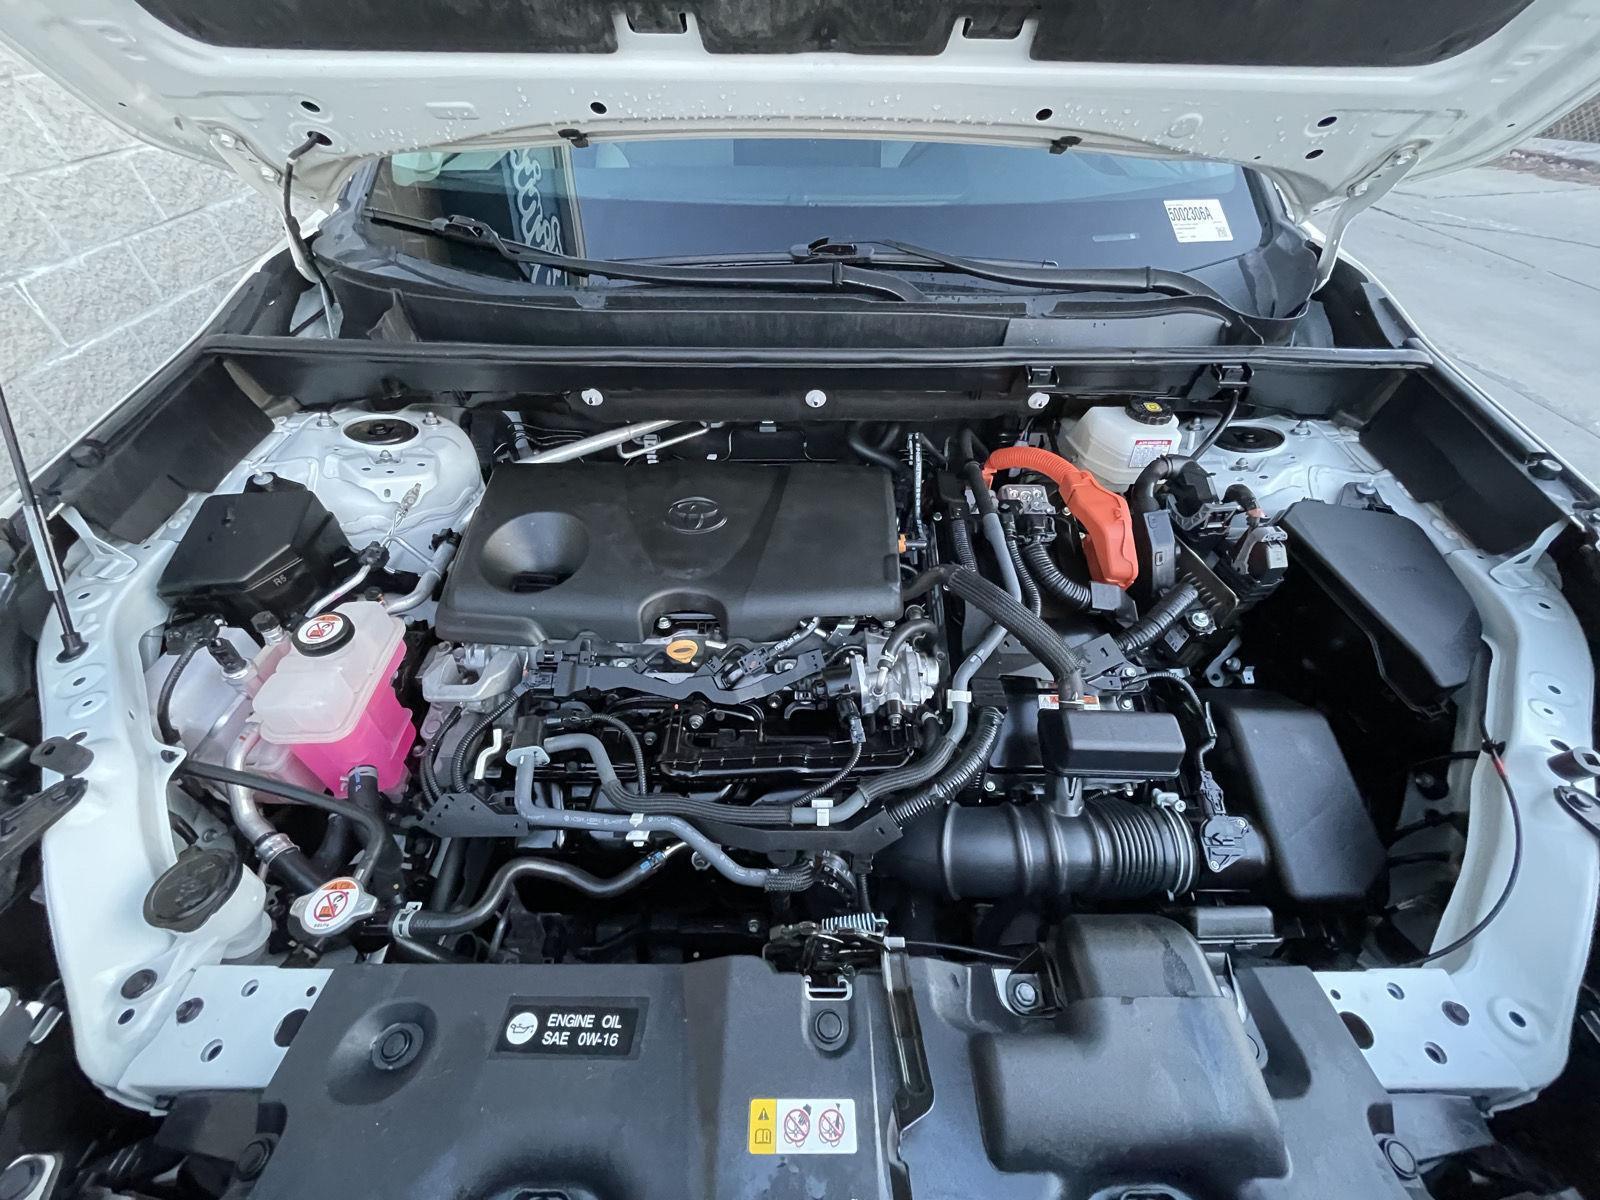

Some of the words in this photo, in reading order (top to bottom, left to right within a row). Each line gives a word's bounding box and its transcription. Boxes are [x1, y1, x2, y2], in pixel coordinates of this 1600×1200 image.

[1168, 206, 1213, 221] 5002306A
[547, 1013, 595, 1028] ENGINE
[602, 1014, 622, 1029] OIL
[542, 1031, 570, 1046] SAE
[577, 1032, 619, 1047] 0W-16
